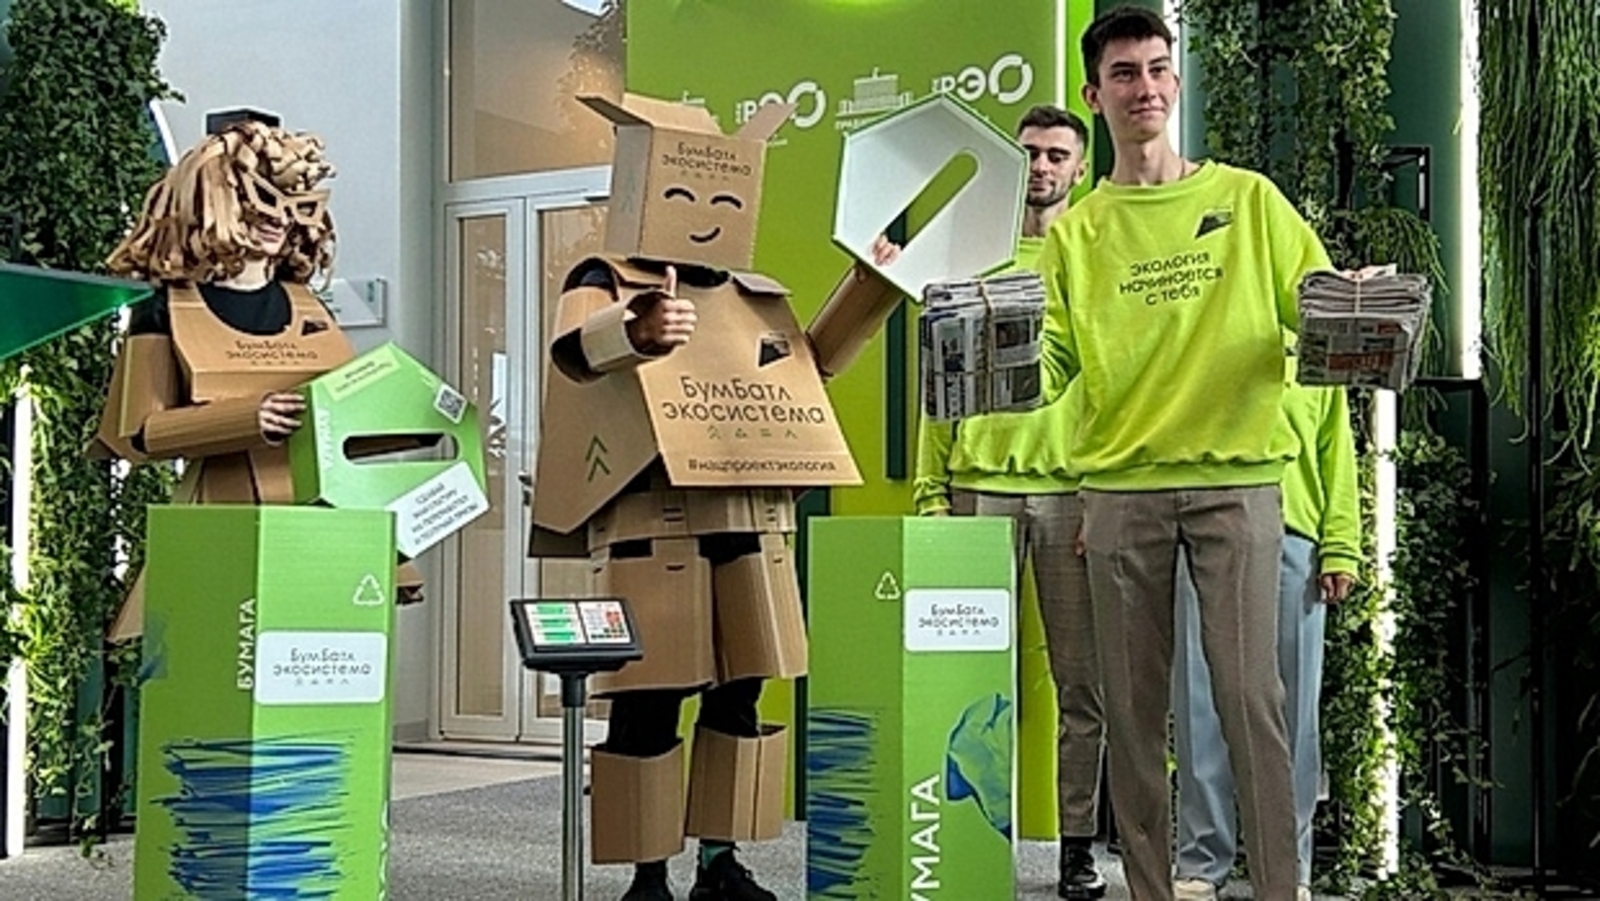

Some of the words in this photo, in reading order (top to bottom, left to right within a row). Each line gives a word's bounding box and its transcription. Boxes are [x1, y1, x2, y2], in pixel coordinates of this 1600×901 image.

[941, 54, 1033, 104] РЭО
[662, 155, 752, 176] экосистема
[1130, 252, 1209, 276] экология
[1119, 267, 1223, 295] начинается
[1146, 293, 1157, 306] с
[1161, 285, 1200, 302] тебя
[680, 376, 792, 401] БумБатл
[663, 403, 826, 425] экосистема
[689, 458, 836, 474] #нацпроектэкология
[918, 616, 998, 627] экосистема
[237, 598, 255, 689] БУМАГА
[290, 648, 354, 662] БумБатл
[273, 663, 371, 676] экосистема
[911, 774, 940, 901] МАГА
